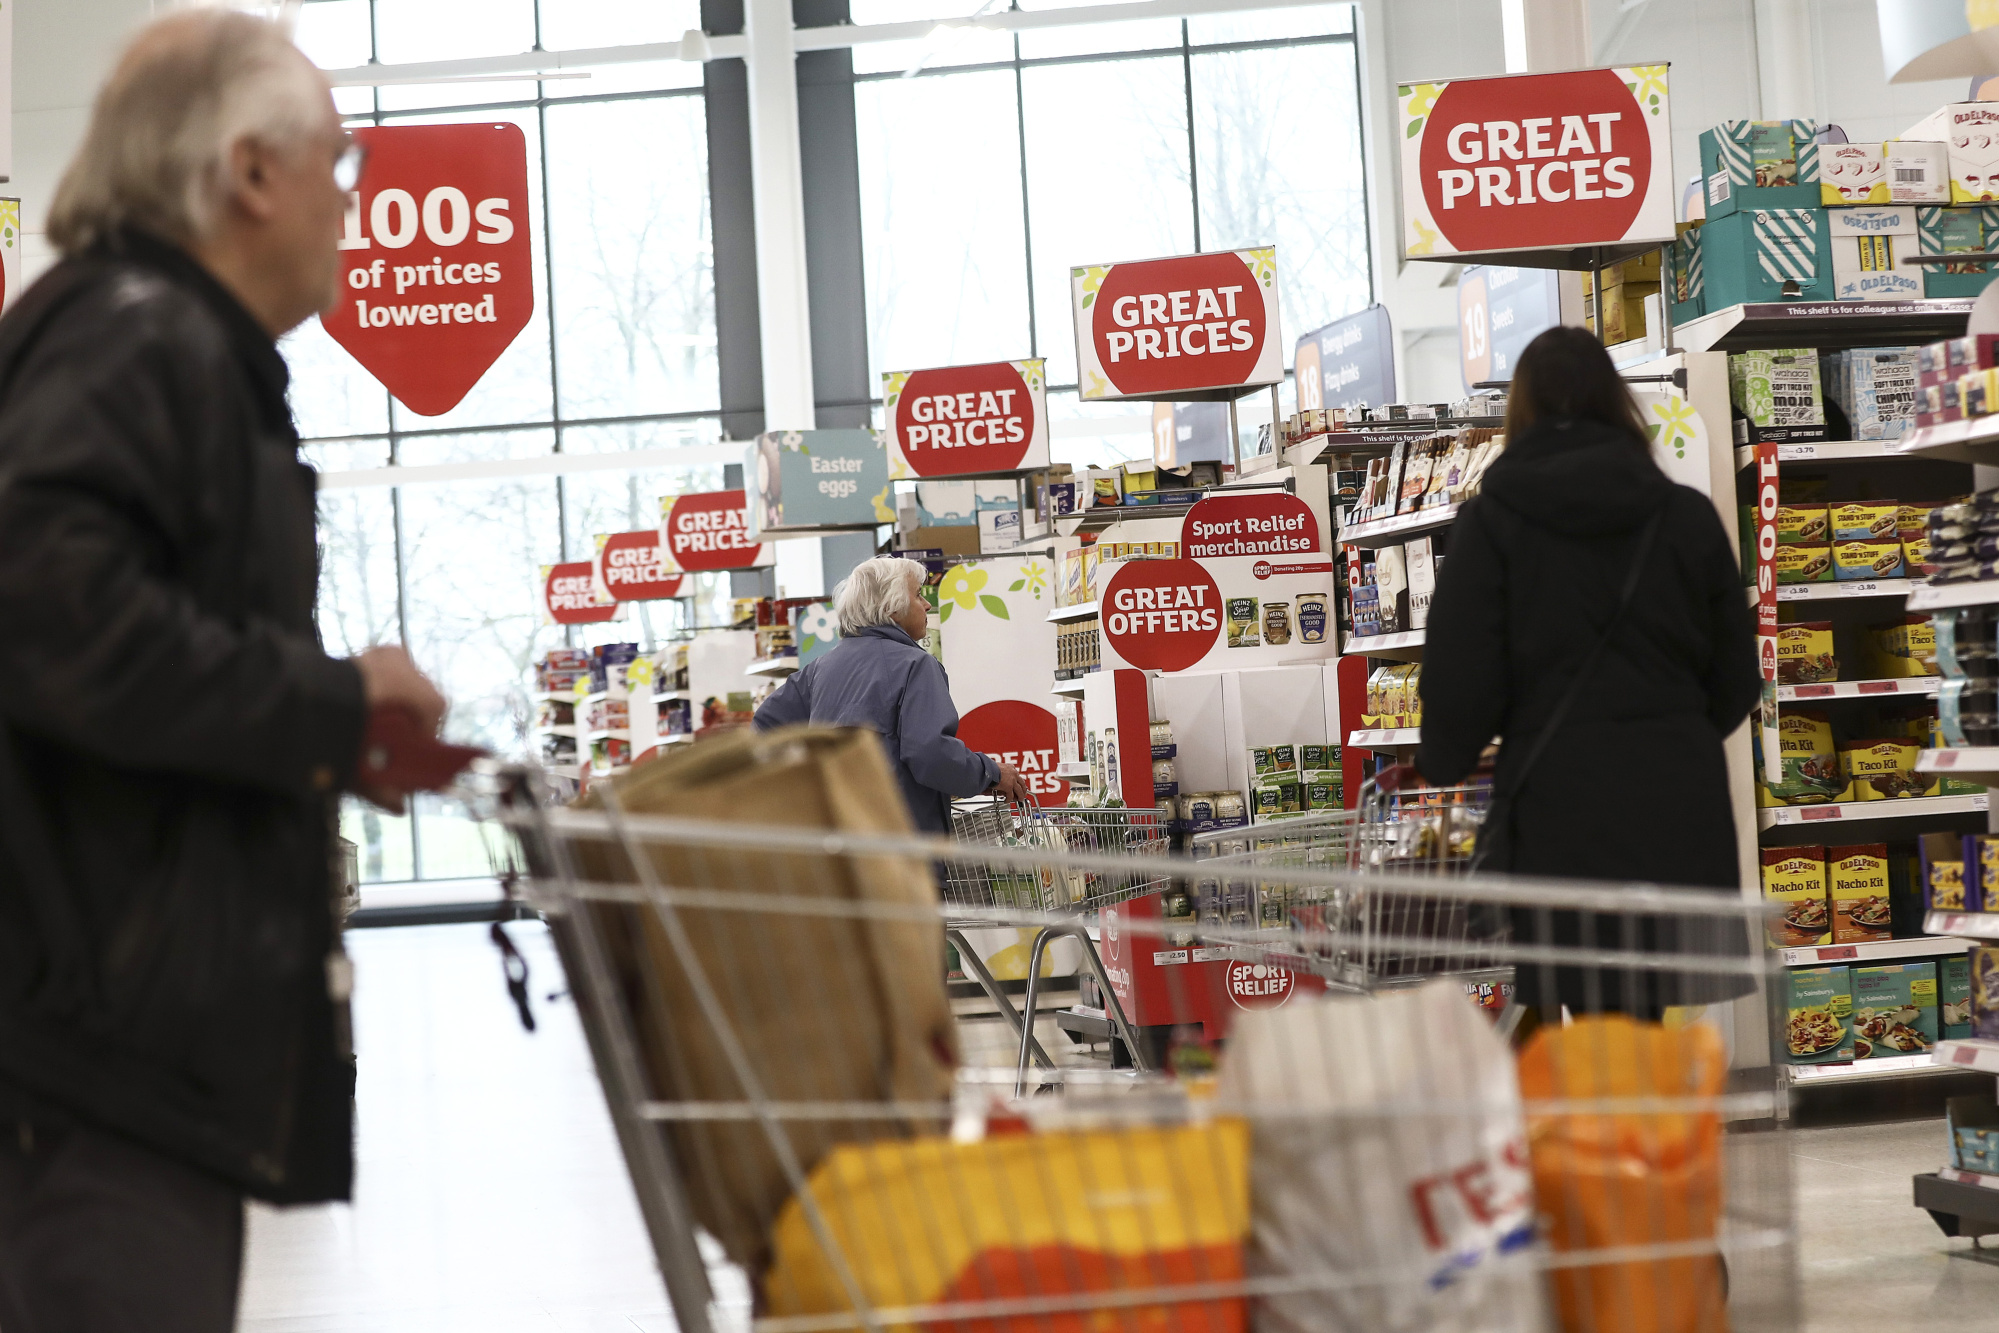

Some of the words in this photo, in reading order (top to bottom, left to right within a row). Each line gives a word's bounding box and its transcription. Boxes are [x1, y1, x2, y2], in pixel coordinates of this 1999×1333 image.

[1446, 112, 1622, 164] GREAT
[1437, 156, 1635, 210] PRICES
[337, 186, 515, 251] 100s
[348, 259, 386, 289] of
[393, 256, 501, 294] prices
[355, 294, 498, 328] lowered
[1112, 285, 1243, 328] GREAT
[1787, 307, 1808, 316] This
[1809, 306, 1830, 316] shelf
[1831, 306, 1840, 314] is
[1841, 306, 1853, 315] for
[1854, 305, 1897, 316] colleague
[1897, 305, 1914, 313] use
[1106, 319, 1254, 363] PRICES
[1465, 302, 1486, 360] 19
[1494, 351, 1507, 372] Tea
[1874, 366, 1910, 375] wahaca
[1773, 368, 1809, 378] wahaca
[1301, 365, 1320, 410] 18
[1876, 391, 1915, 405] CHIPOTL
[911, 389, 1017, 423] GREAT
[906, 416, 1025, 451] PRICES
[1156, 417, 1172, 463] 17
[810, 456, 864, 474] Easter
[818, 479, 858, 499] eggs
[677, 508, 748, 533] GREAT
[1192, 520, 1243, 540] Sport
[1246, 513, 1306, 533] Relief
[674, 530, 758, 553] PRICES
[1190, 535, 1311, 557] merchandise
[609, 547, 660, 568] GREA
[1115, 585, 1209, 611] GREAT
[1302, 604, 1322, 613] HEINZ
[1108, 608, 1218, 636] OFFERS
[1792, 643, 1807, 655] Kit
[1911, 637, 1931, 645] Taco
[1798, 739, 1814, 751] Kit
[1858, 761, 1882, 771] Taco
[1884, 759, 1898, 769] Kit
[1771, 882, 1804, 893] Nacho
[1805, 879, 1821, 891] Kit
[1836, 879, 1868, 890] Nacho
[1870, 877, 1885, 888] Kit
[1234, 979, 1289, 996] RELIEF
